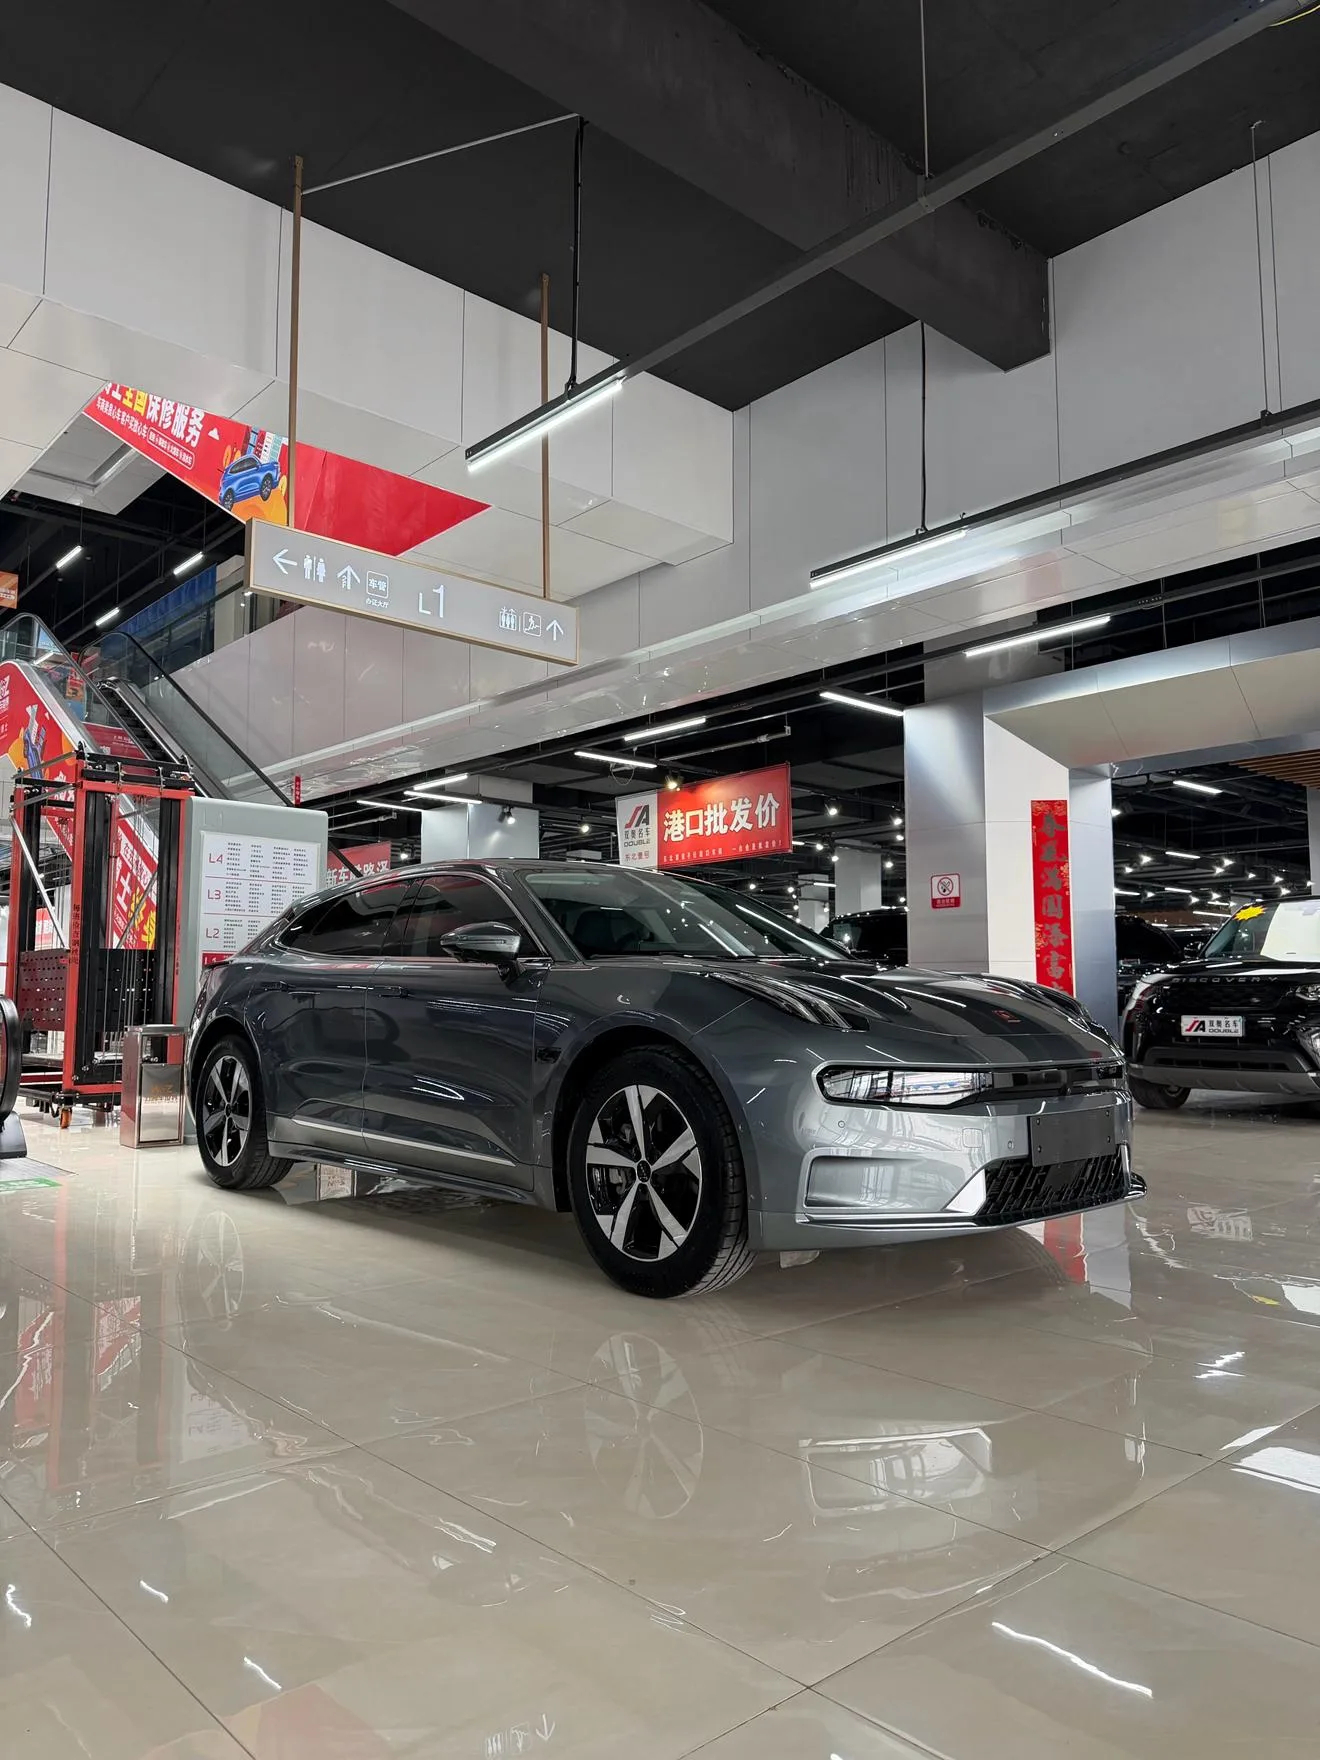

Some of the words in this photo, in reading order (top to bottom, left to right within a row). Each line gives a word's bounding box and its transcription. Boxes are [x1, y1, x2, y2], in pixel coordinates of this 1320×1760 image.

[368, 578, 387, 592] 车管
[418, 584, 445, 619] L1
[663, 792, 780, 843] 港口批发价
[208, 852, 223, 864] L4
[207, 889, 222, 900] L3
[205, 927, 220, 939] L2
